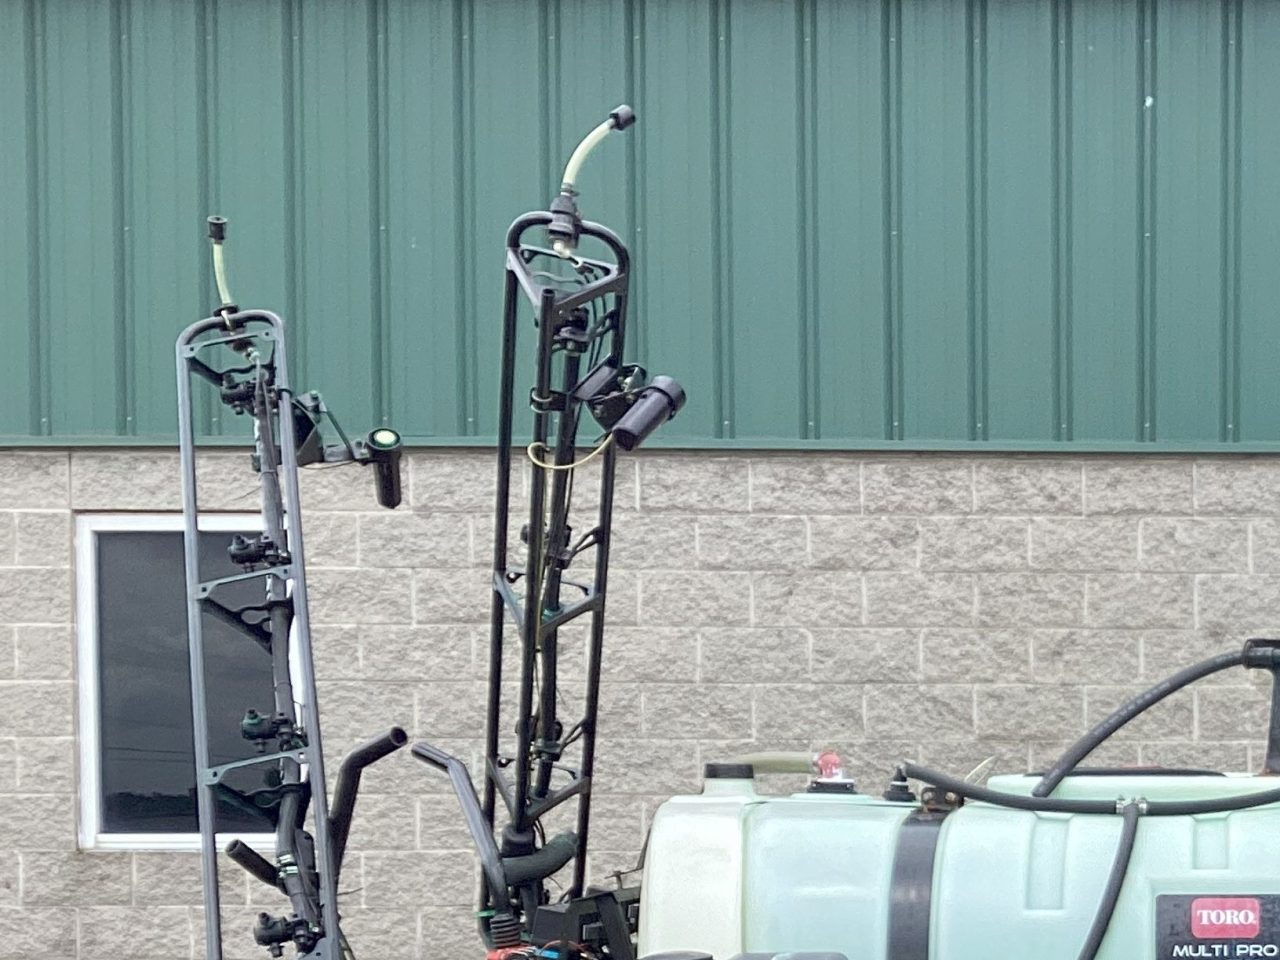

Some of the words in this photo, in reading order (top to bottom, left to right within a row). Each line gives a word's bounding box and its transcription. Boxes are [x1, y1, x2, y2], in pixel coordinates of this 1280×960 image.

[1196, 909, 1254, 925] TORO
[1172, 944, 1228, 957] MULTI
[1236, 944, 1278, 957] PRO
